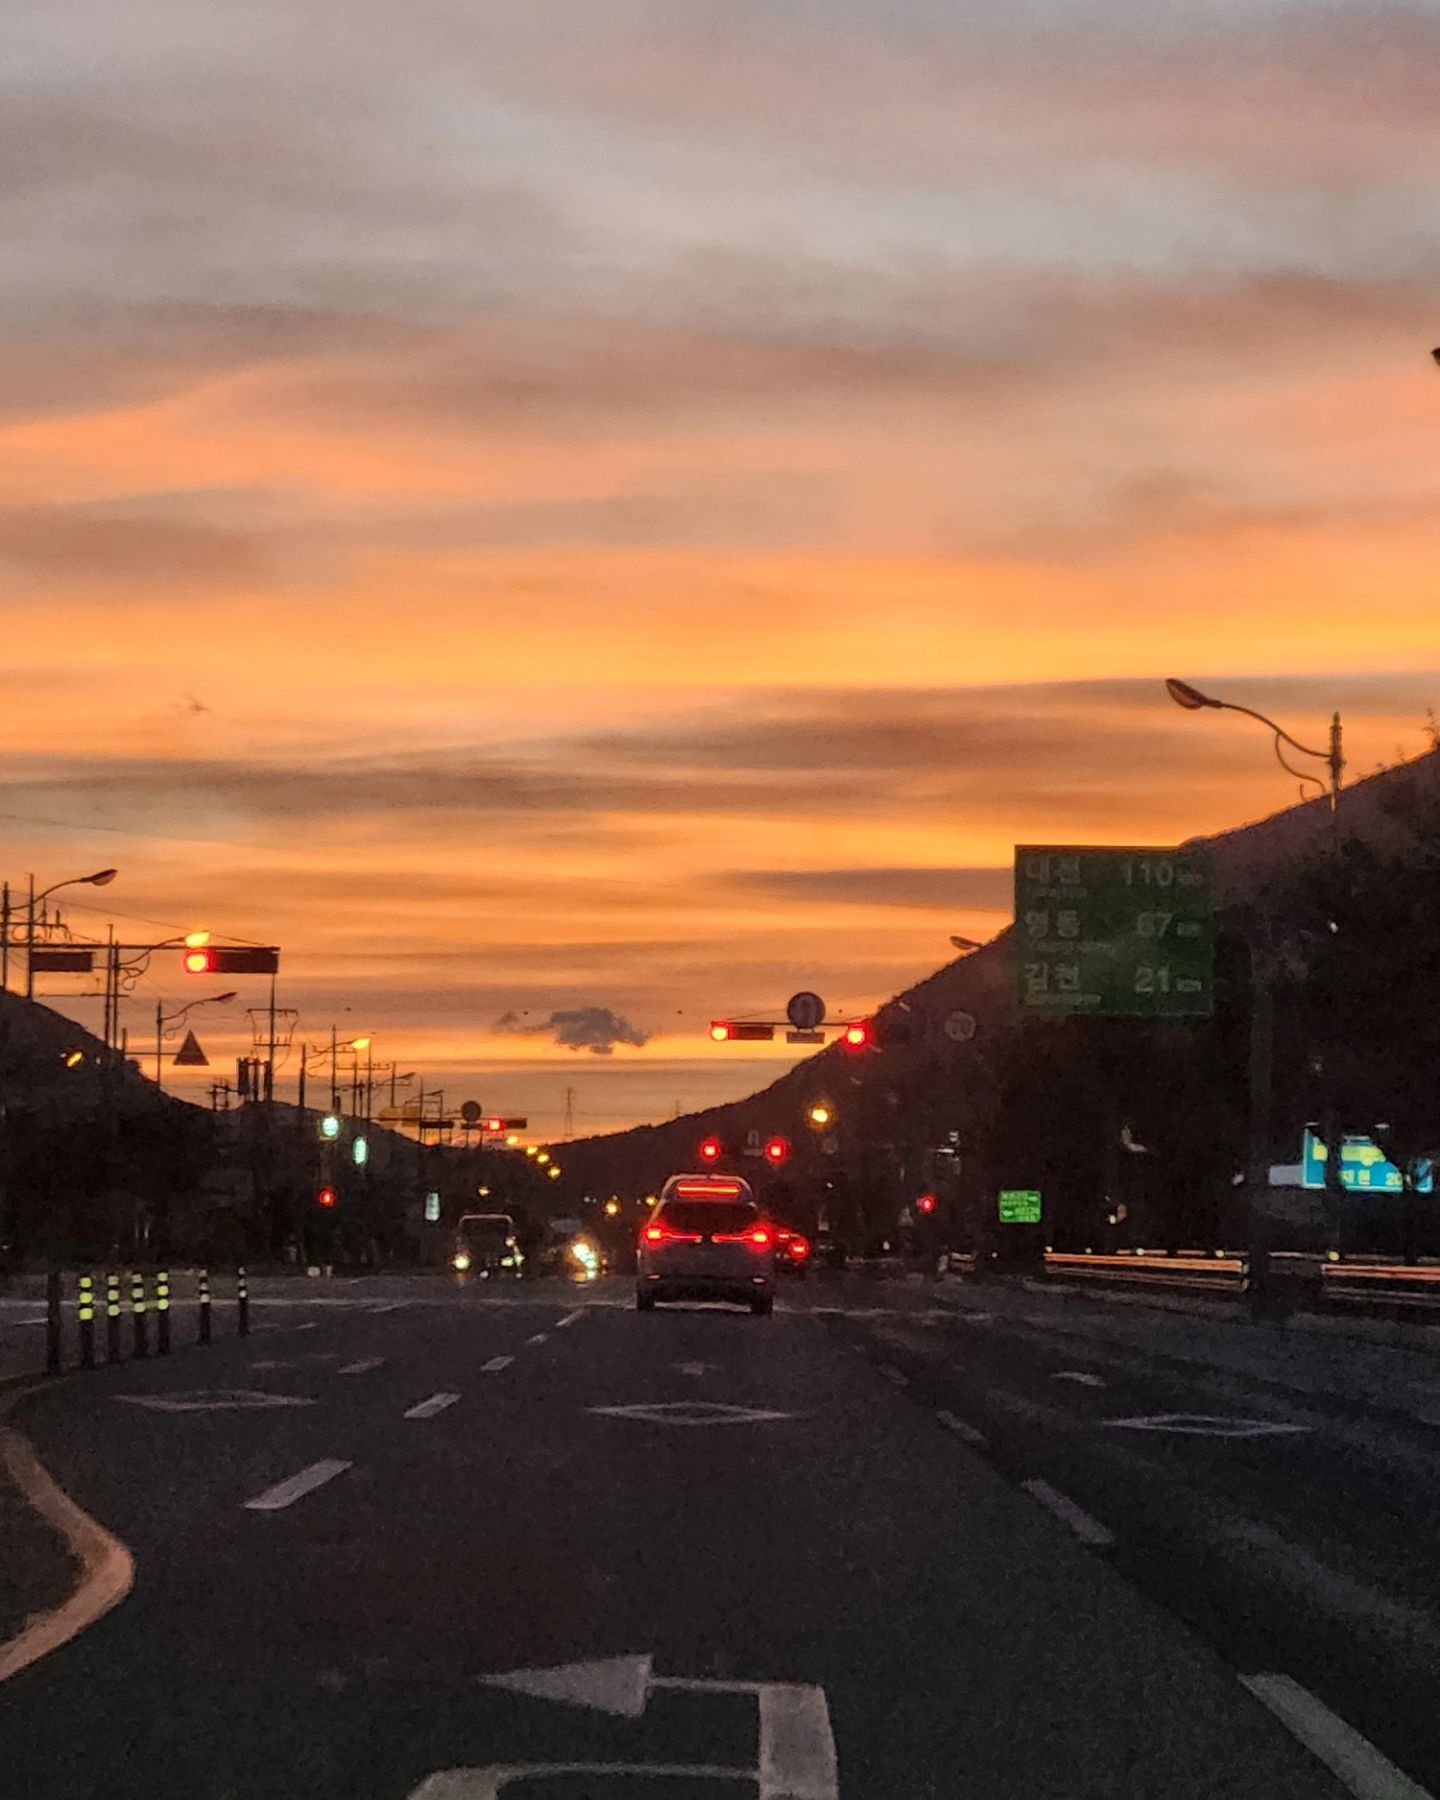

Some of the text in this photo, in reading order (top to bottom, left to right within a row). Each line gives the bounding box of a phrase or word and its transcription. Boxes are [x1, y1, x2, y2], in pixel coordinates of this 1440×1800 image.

[1122, 861, 1174, 886] 110
[1136, 912, 1173, 938] 67
[1024, 962, 1081, 991] 김천
[1134, 965, 1171, 993] 21
